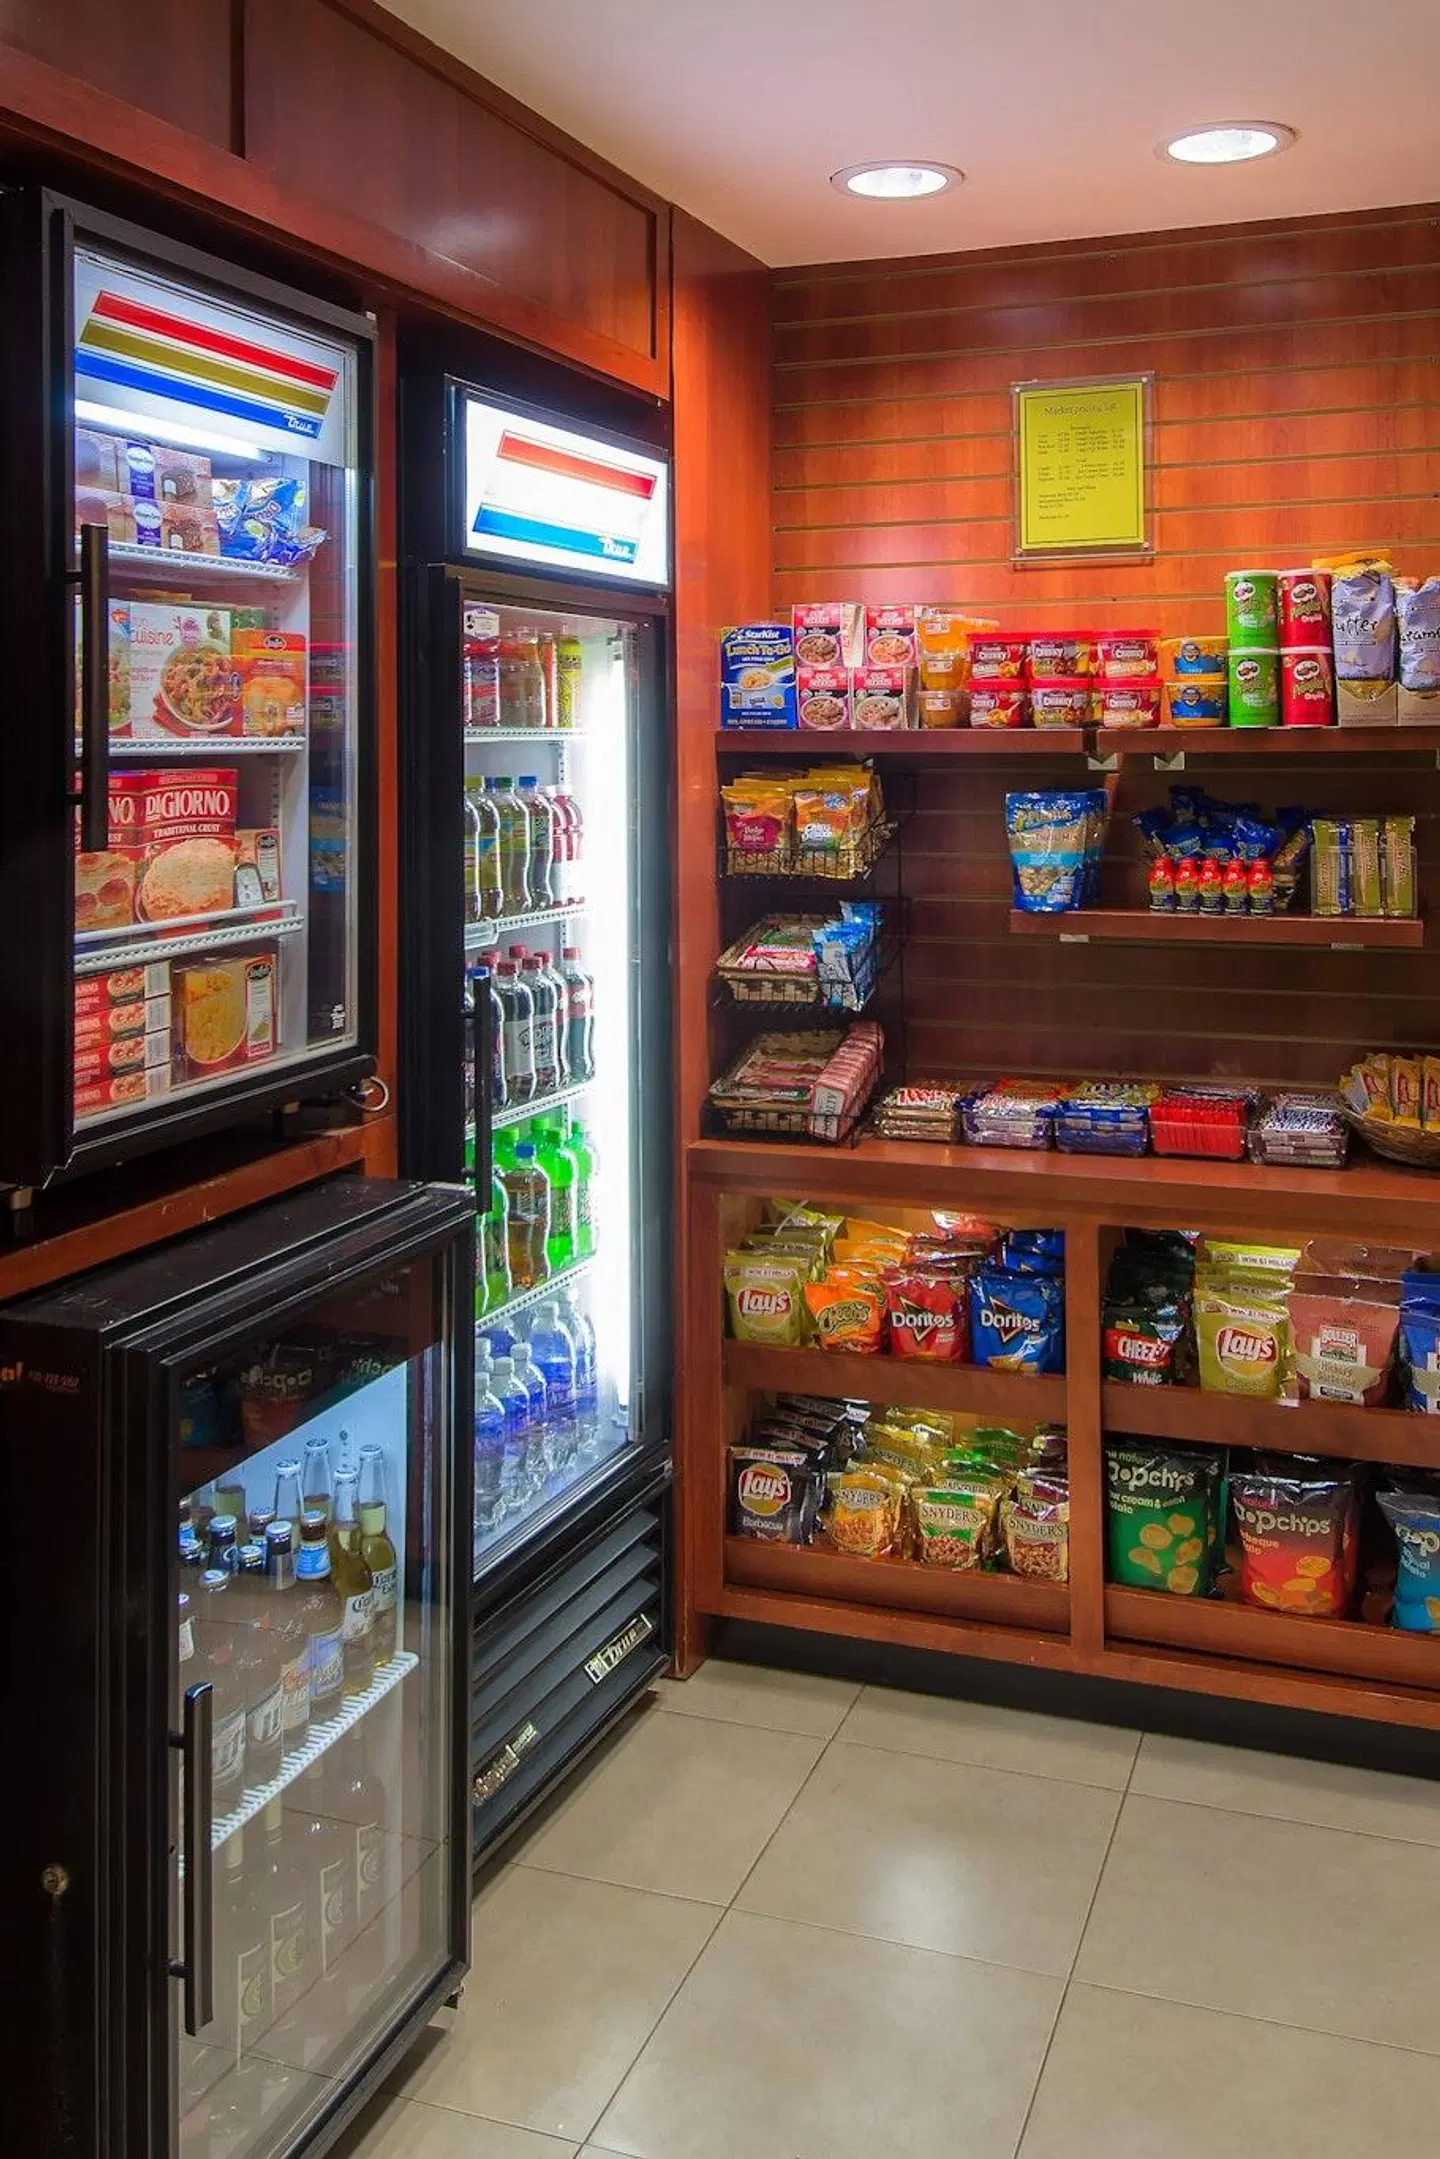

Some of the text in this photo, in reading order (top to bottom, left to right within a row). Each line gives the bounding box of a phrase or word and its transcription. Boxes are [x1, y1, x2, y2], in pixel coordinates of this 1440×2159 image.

[108, 795, 133, 824] NO
[741, 1288, 790, 1316] Lay's
[891, 1311, 955, 1328] Doritos
[980, 1308, 1041, 1332] Doritos
[1219, 1328, 1274, 1361] Lay's
[743, 1471, 786, 1500] Lay's
